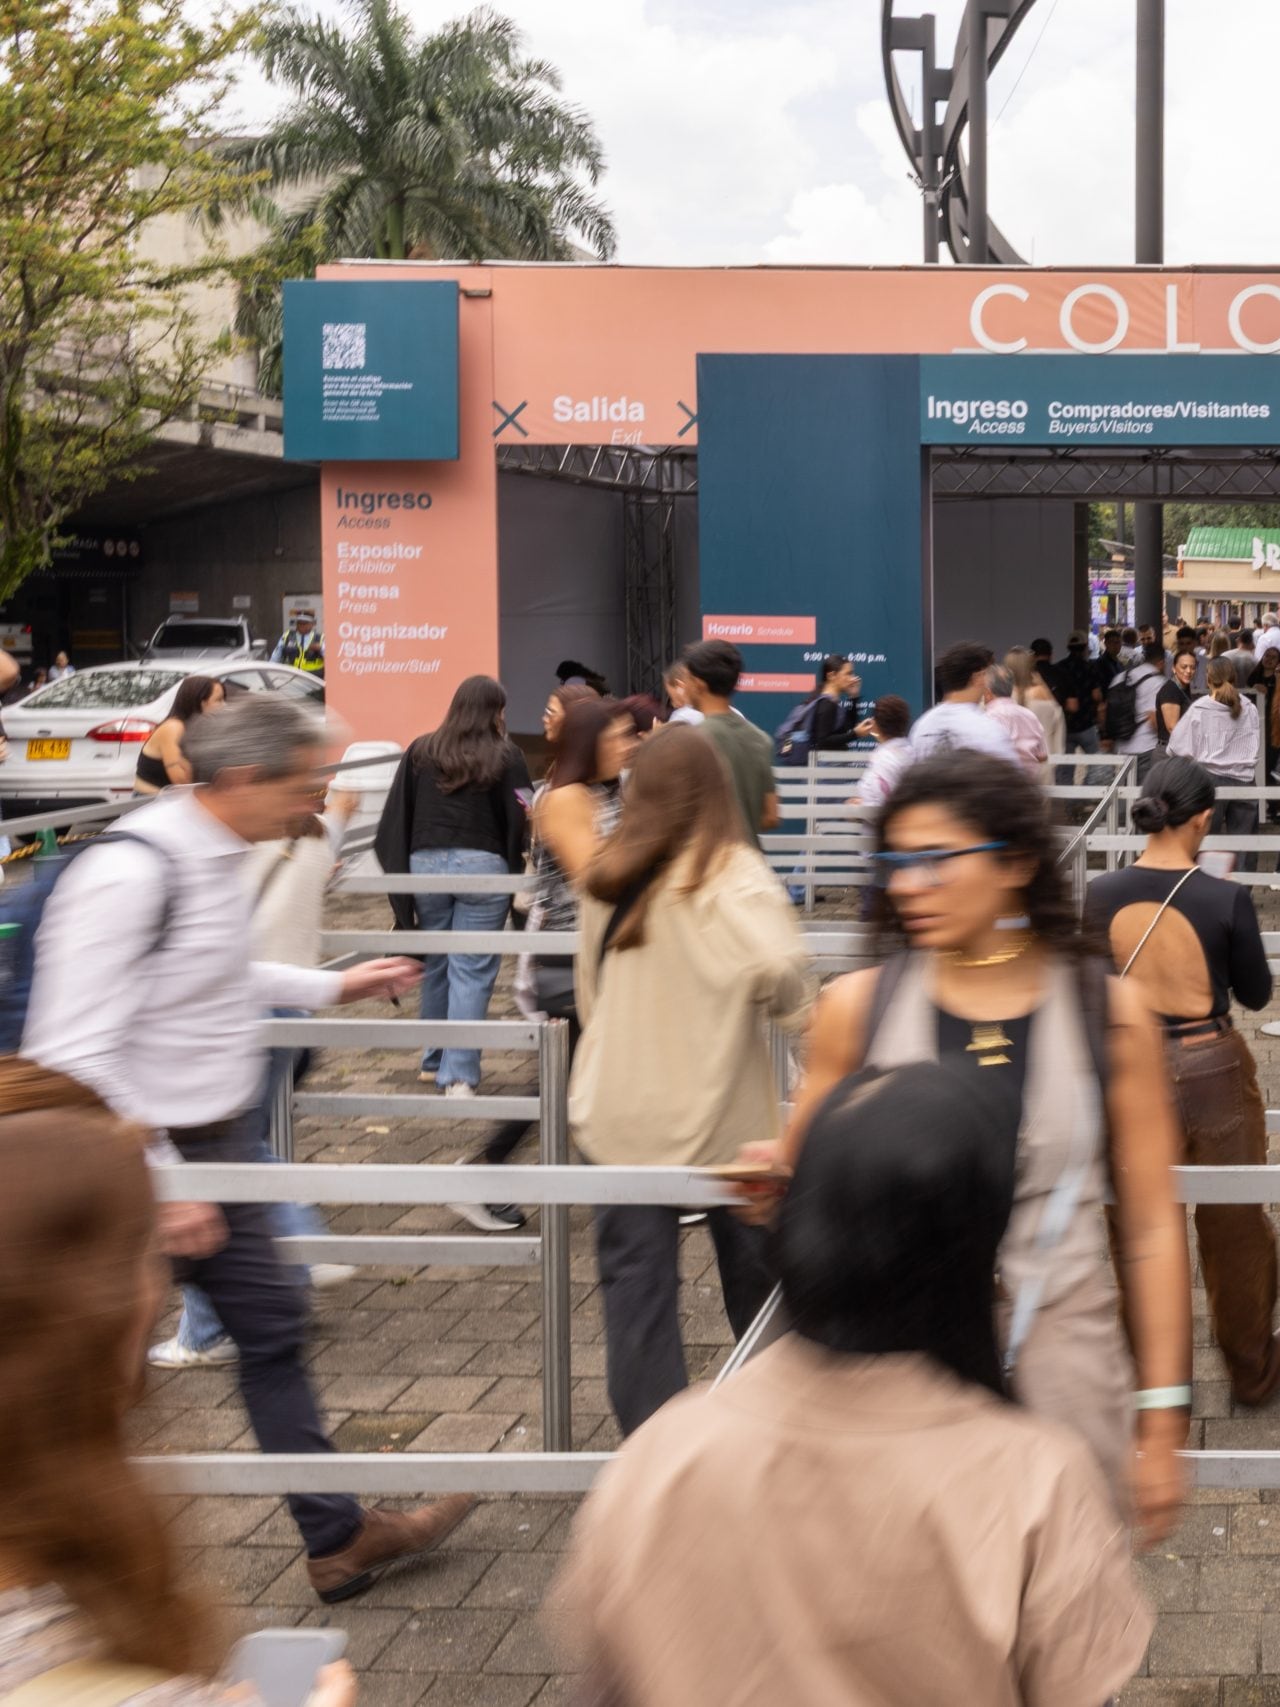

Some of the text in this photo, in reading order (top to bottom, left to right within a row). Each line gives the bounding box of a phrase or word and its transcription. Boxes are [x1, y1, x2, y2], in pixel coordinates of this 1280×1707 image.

[553, 395, 645, 423] Salida
[927, 396, 1270, 424] Ingreso Compradores/Visitantes
[968, 420, 1025, 434] Access
[611, 429, 642, 446] Exit
[336, 488, 432, 513] Ingreso
[336, 515, 391, 529] Access
[337, 542, 423, 560] Expositor
[337, 560, 396, 574] Exhibitor
[337, 582, 400, 599] Prensa
[338, 600, 377, 614] Press
[338, 622, 448, 642] Organizador
[708, 623, 753, 635] Horario
[337, 641, 385, 658] /Staff
[848, 652, 867, 662] 6:00
[338, 659, 441, 675] Organizer/Staff
